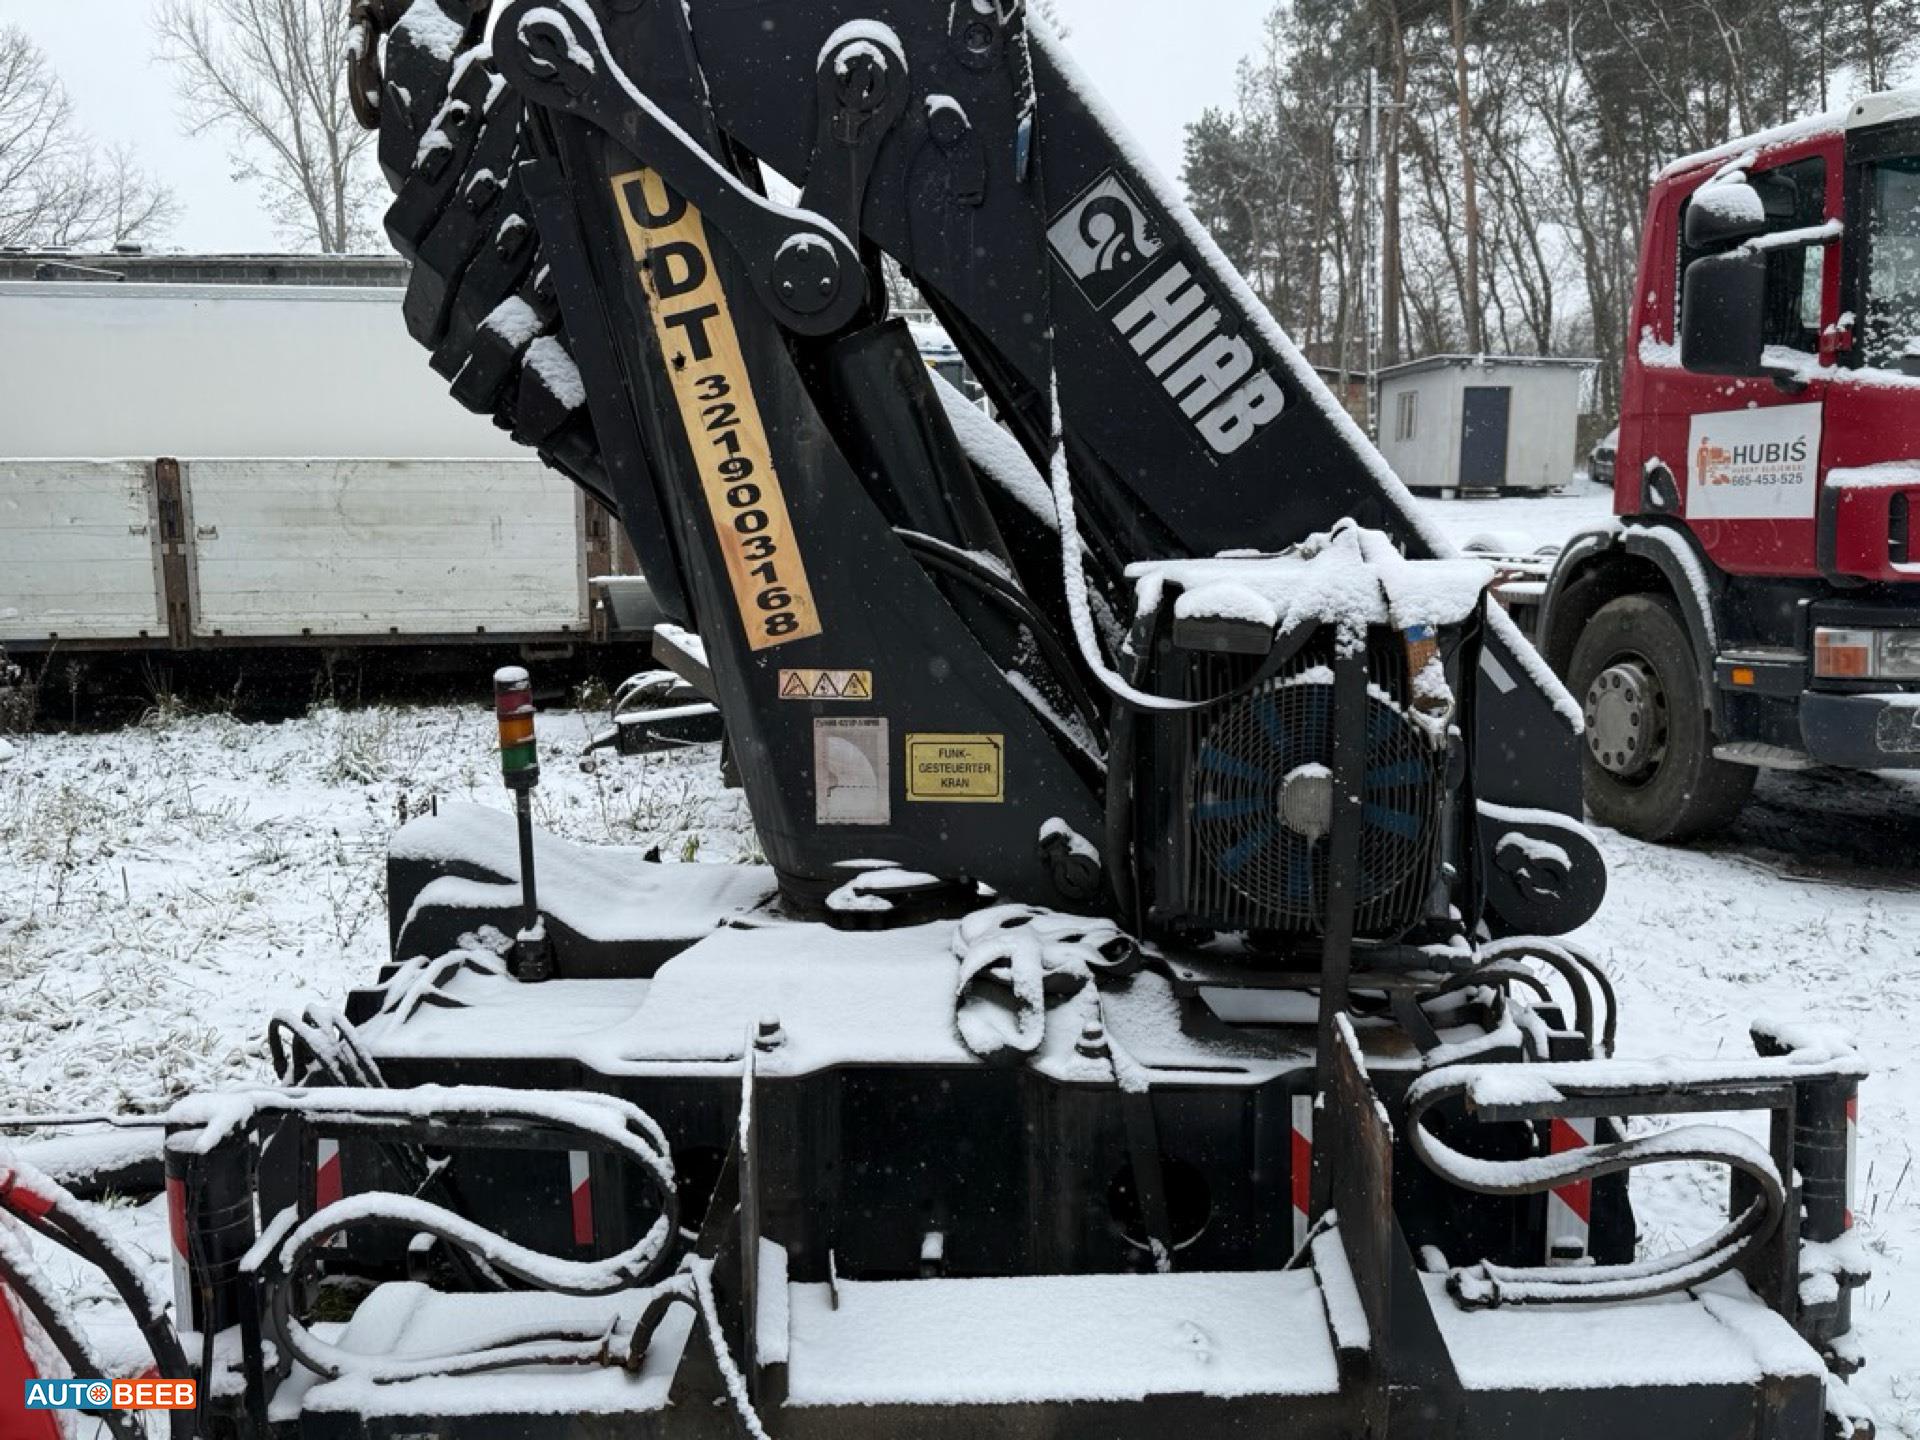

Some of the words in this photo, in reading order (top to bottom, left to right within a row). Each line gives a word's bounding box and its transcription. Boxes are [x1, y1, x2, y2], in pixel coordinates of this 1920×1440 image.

[1112, 260, 1286, 455] HIAB
[621, 177, 720, 364] UDT
[693, 373, 801, 638] 3219003168
[1733, 434, 1807, 465] HUBIŚ
[938, 747, 972, 759] FUNK-
[918, 762, 992, 774] GESTEUERTER
[940, 777, 970, 788] KRAN
